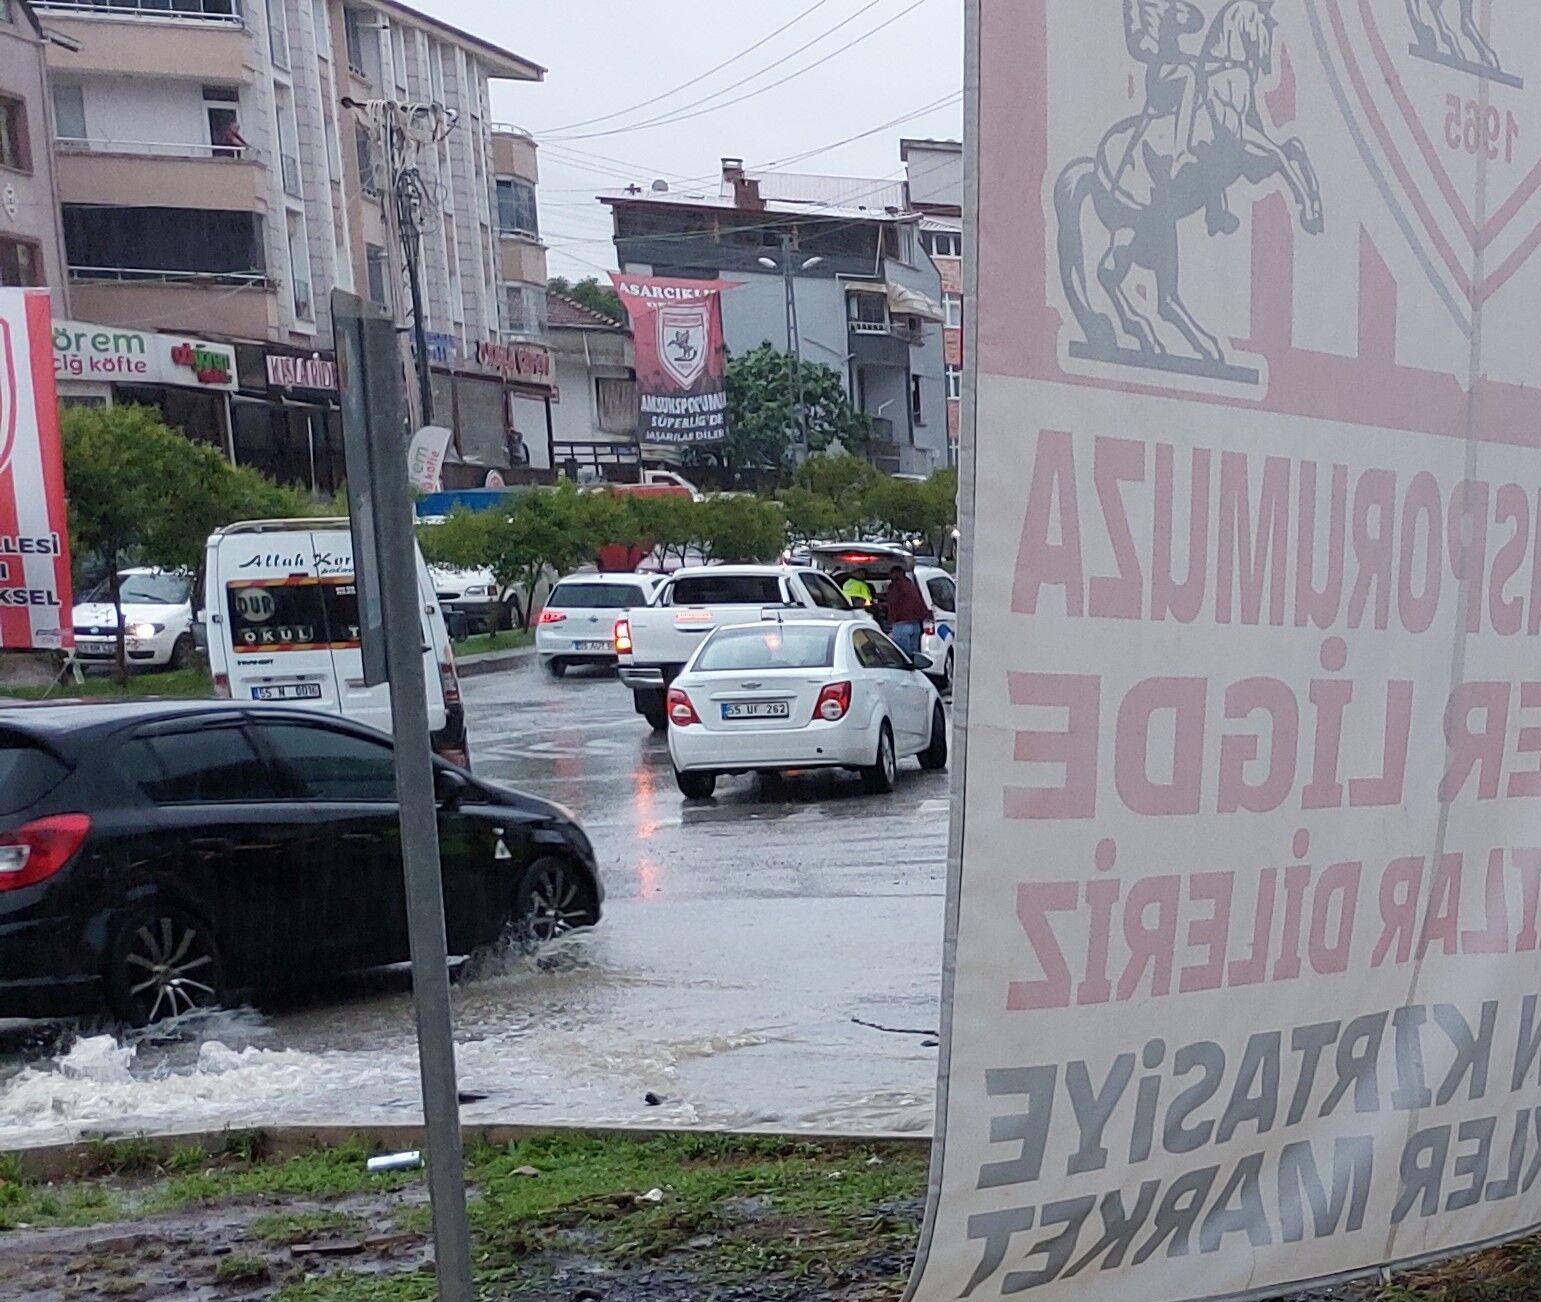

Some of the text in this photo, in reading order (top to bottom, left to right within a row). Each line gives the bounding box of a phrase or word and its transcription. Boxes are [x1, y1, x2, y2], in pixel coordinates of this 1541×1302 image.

[53, 327, 145, 354] örem
[89, 355, 147, 373] köfte
[239, 553, 304, 568] Allah
[243, 628, 309, 642] OKUL
